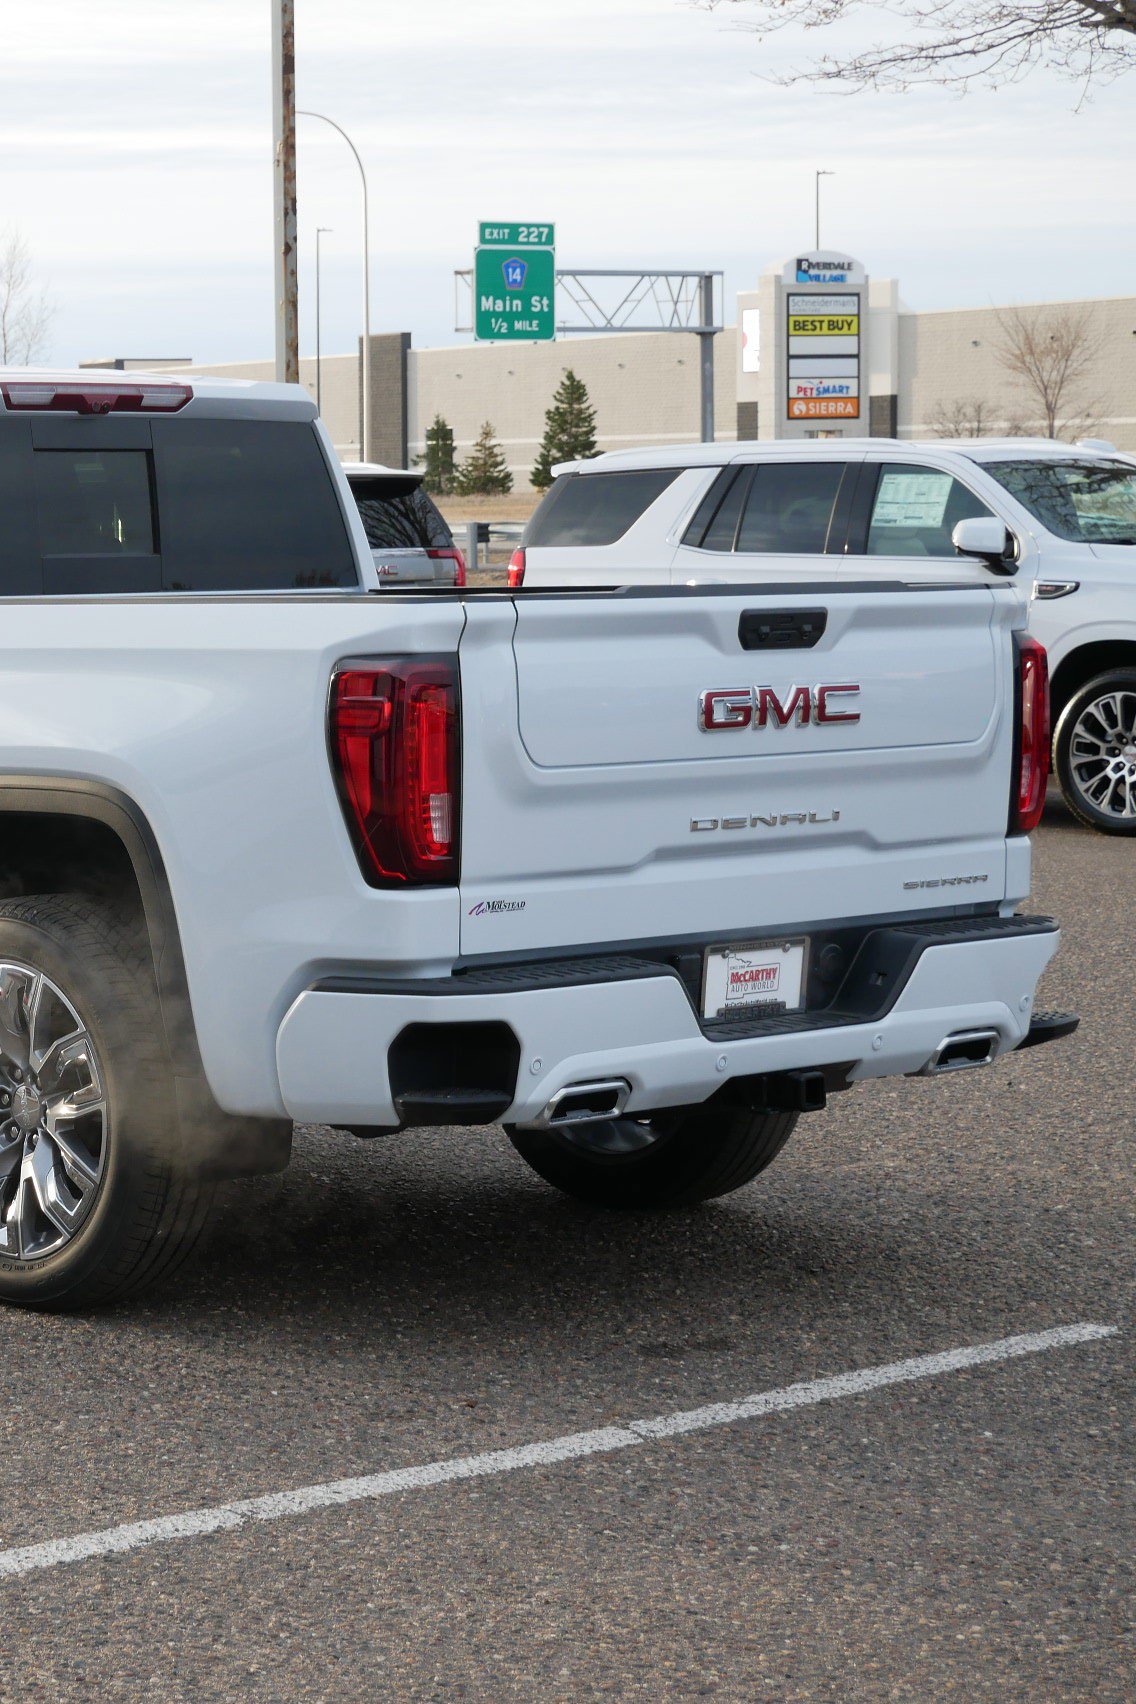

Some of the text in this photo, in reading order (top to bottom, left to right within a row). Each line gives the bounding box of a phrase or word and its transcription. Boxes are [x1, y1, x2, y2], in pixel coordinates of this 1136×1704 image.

[484, 227, 549, 242] EXIT 227
[508, 267, 521, 283] 14
[808, 273, 846, 283] VILLAGE
[481, 296, 549, 312] Main St
[514, 320, 539, 331] MILE
[793, 319, 854, 332] BEST BUY
[808, 402, 854, 414] SIERRA
[697, 681, 861, 734] GMC
[690, 809, 840, 832] DENALI
[903, 874, 988, 889] SIERRA
[729, 966, 778, 984] McCARTHY
[730, 980, 775, 993] AUTO WORLD
